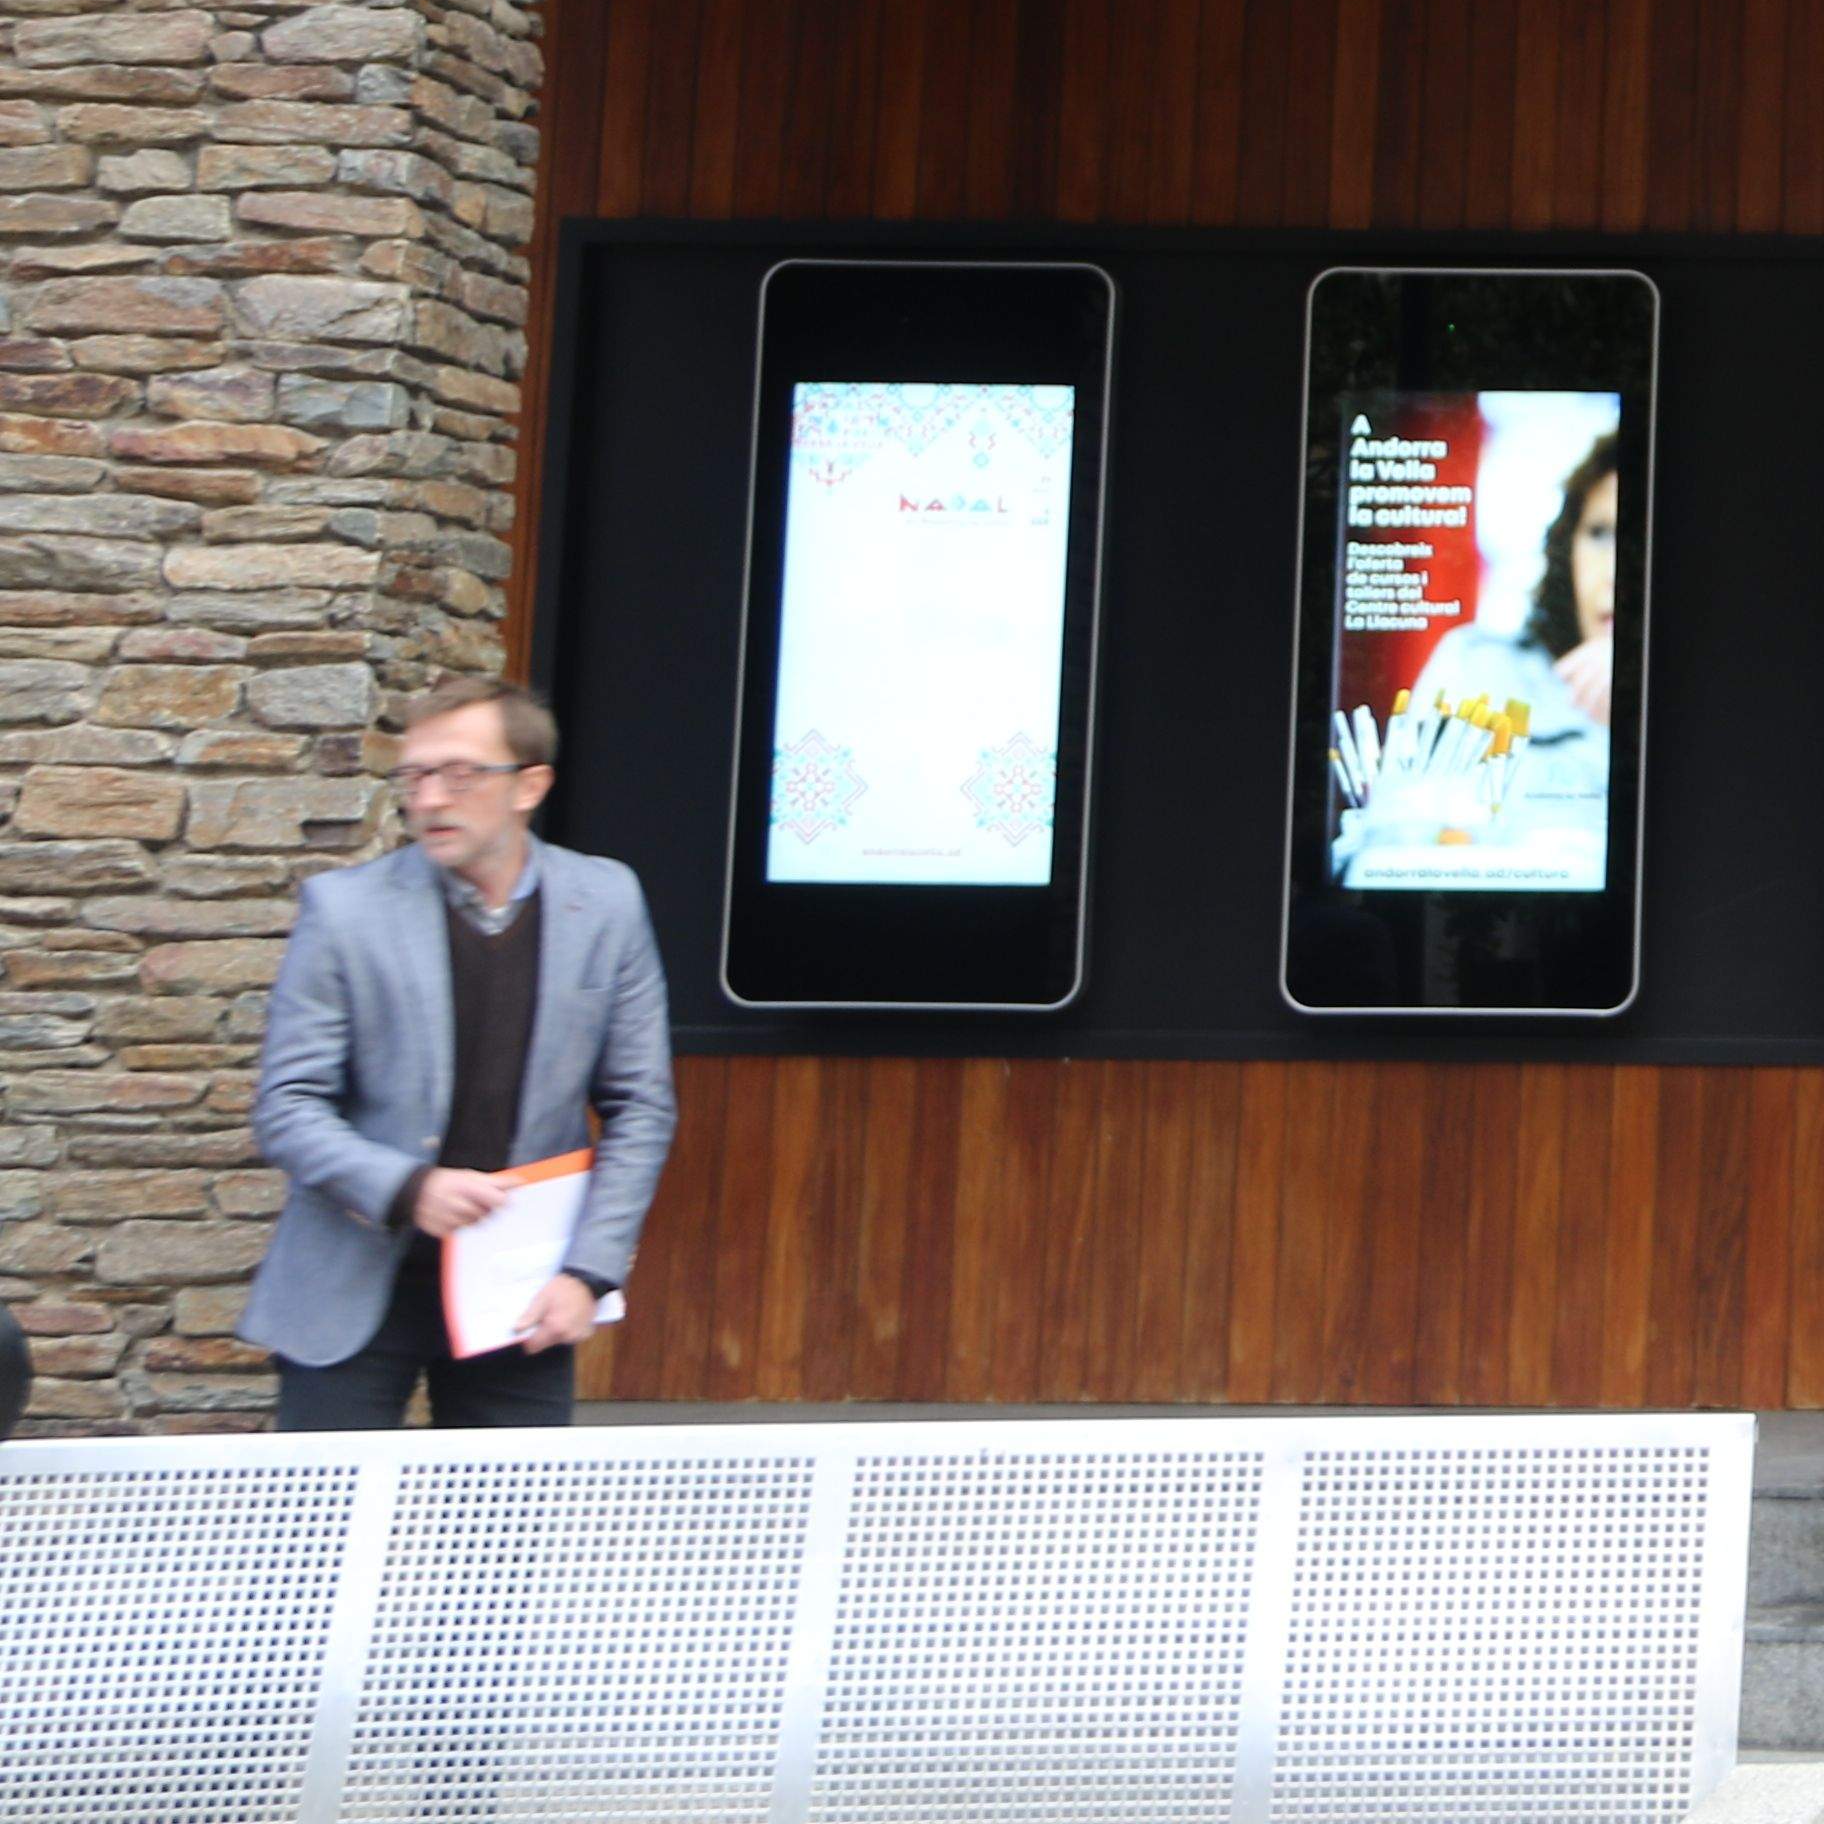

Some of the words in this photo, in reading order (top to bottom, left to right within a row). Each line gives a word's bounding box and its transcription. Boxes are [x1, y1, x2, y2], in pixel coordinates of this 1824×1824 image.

[1350, 414, 1371, 435] A
[1350, 437, 1447, 458] Andorra
[1350, 459, 1375, 480] la
[1376, 459, 1436, 481] Vella
[1349, 486, 1473, 505] promovem
[1349, 504, 1373, 527] la
